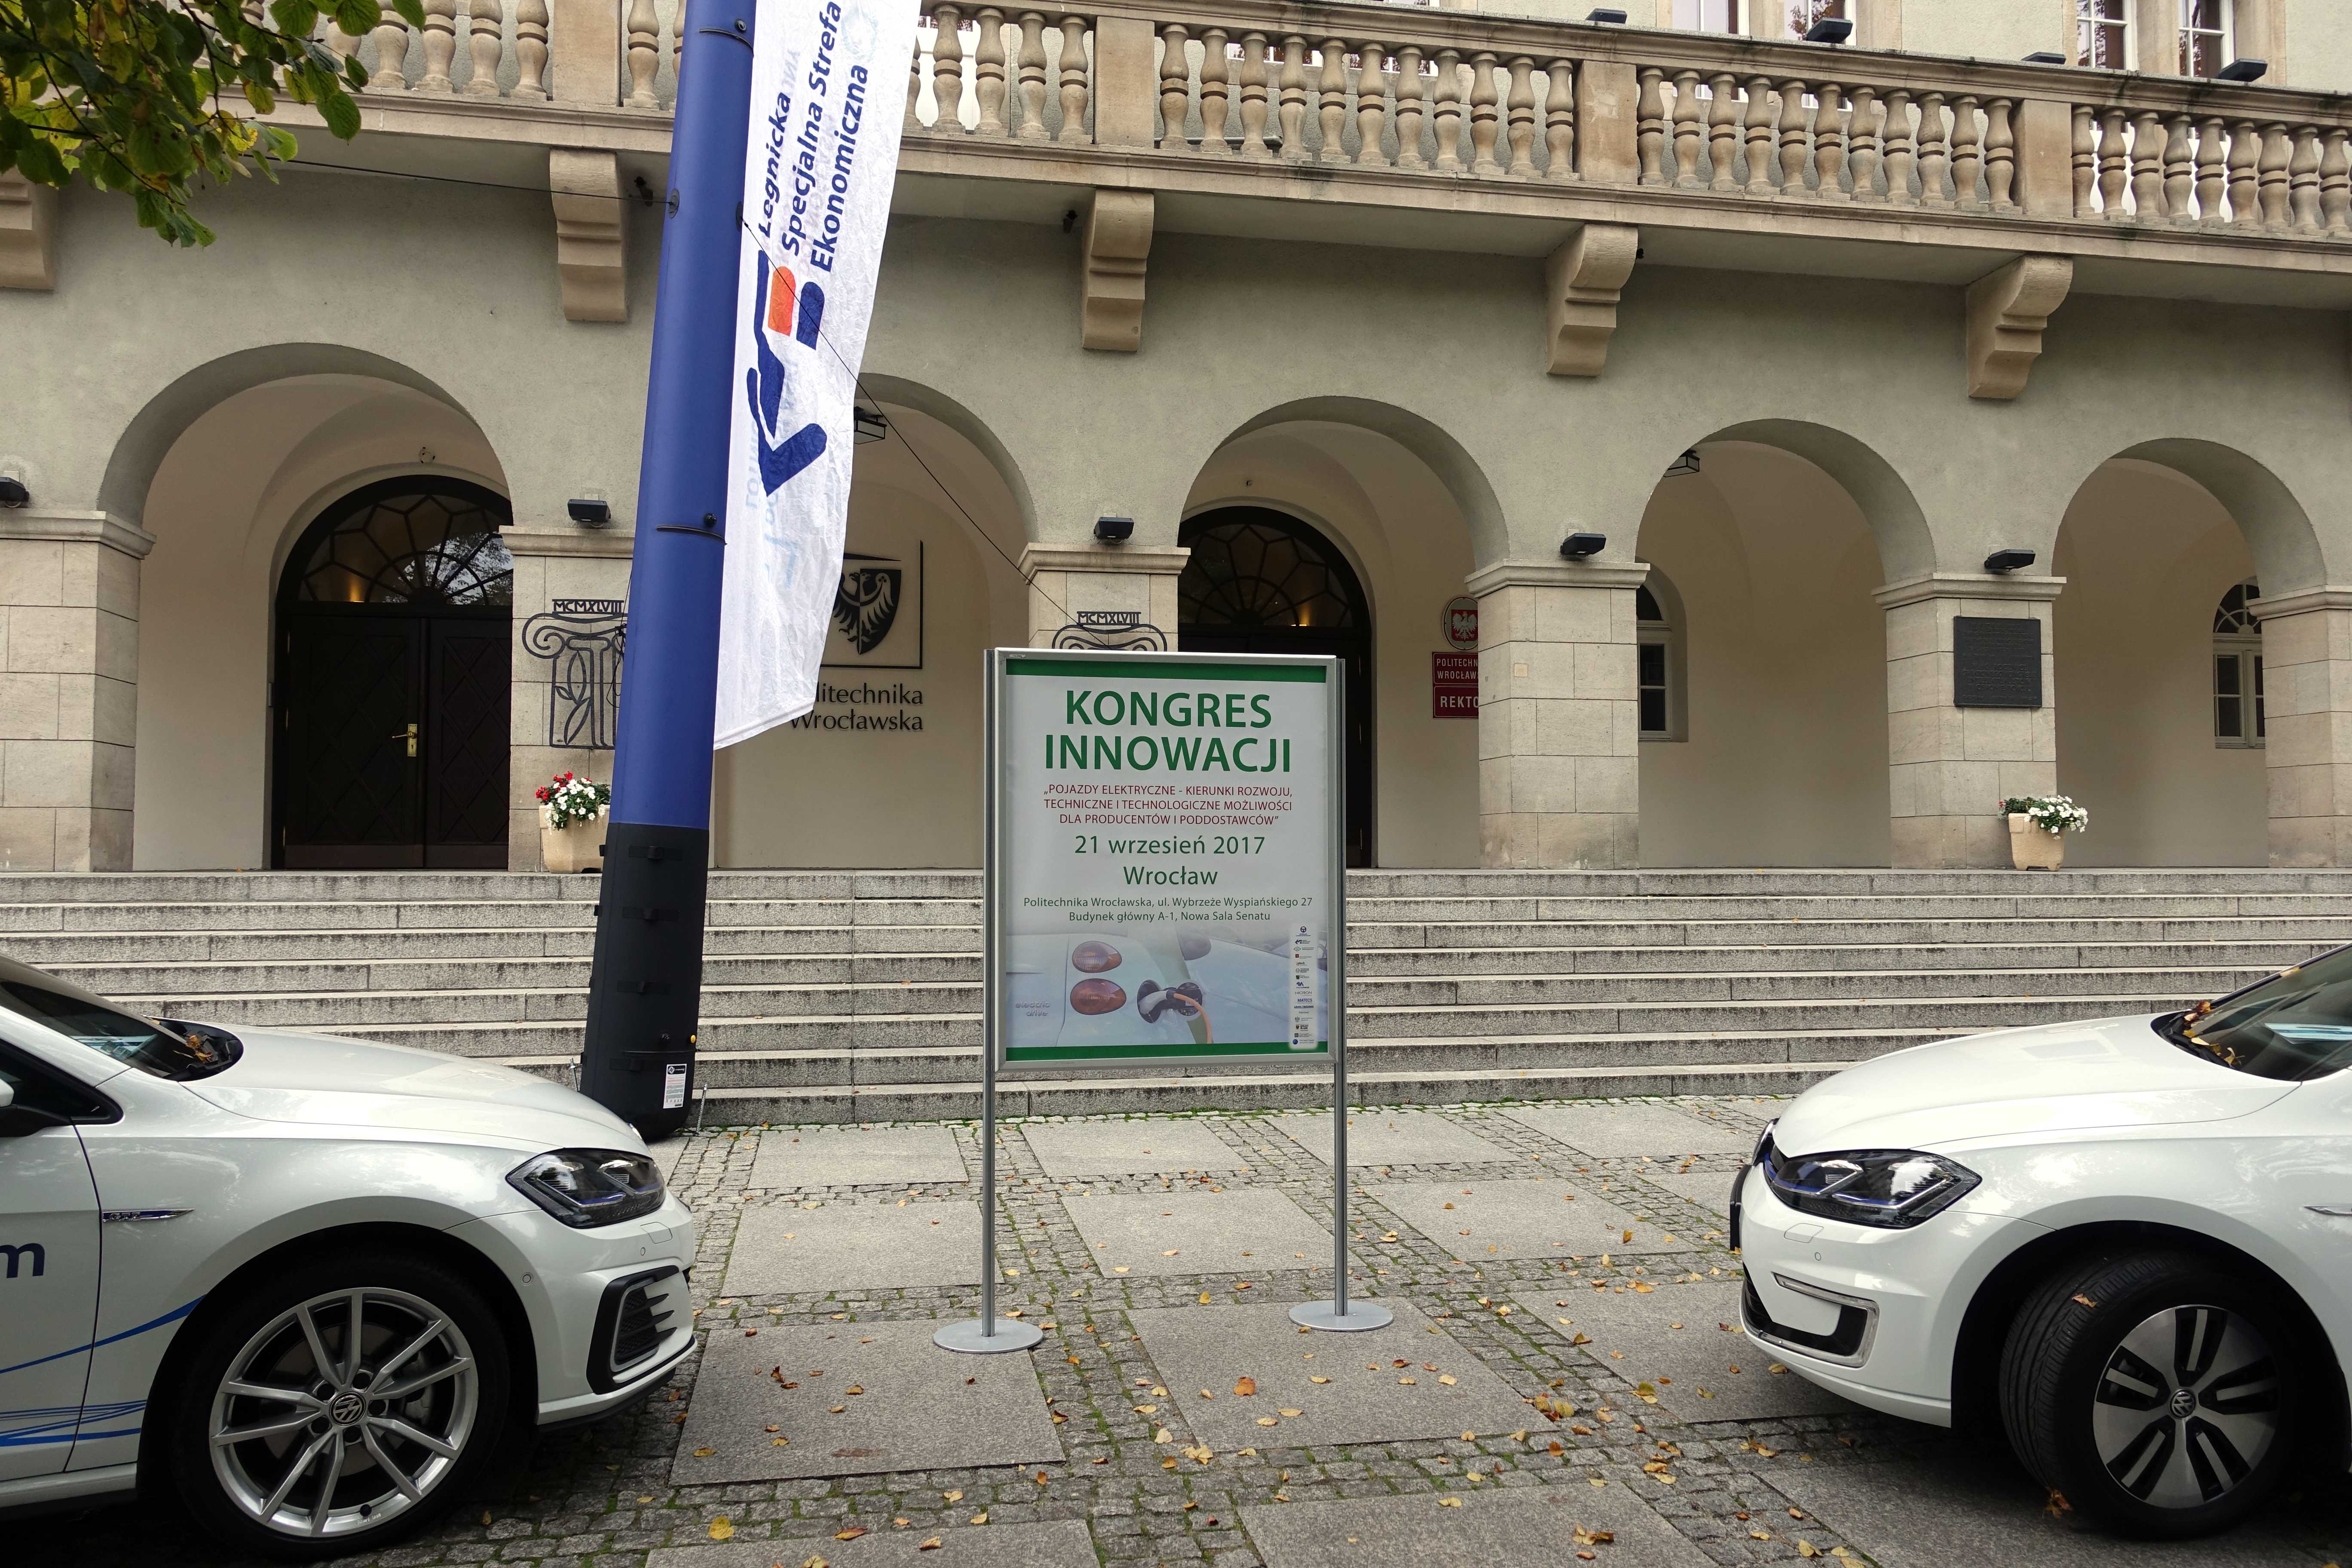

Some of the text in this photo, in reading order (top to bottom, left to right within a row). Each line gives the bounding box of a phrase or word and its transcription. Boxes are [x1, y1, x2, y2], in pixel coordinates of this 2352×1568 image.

[781, 101, 824, 257] Specjalna
[809, 1, 841, 97] Strefa
[757, 91, 791, 238] Legnicka
[810, 64, 868, 273] Ekonomiczna
[554, 600, 624, 613] MCMXLVIII
[1078, 612, 1140, 625] MCMXLVIII
[1436, 658, 1478, 667] POLITECHN
[1437, 671, 1479, 680] WROCŁAW
[816, 681, 923, 704] litechnika
[1440, 695, 1479, 708] REKTO
[1067, 690, 1271, 729] KONGRES
[791, 709, 923, 730] Wrocławska
[1046, 735, 1290, 772] INNOWACJI
[1102, 785, 1176, 795] ELEKTRYCZNE
[1186, 786, 1234, 796] KIERUNKI
[1238, 787, 1292, 798] ROZWOJU,
[1044, 799, 1292, 811] TECHNICZNE I TECHNOLOGICZNE MOŻLIWOŚCI
[1060, 814, 1081, 824] DLA
[1085, 813, 1170, 824] PRODUCENTÓW
[1174, 815, 1176, 824] I
[1075, 835, 1265, 854] 21 wrzesień 2017
[1123, 866, 1218, 885] Wrocław
[1024, 897, 1312, 909] Politechnika Wrocławska, ul. Wybrzeże Wyspiańskiego 27
[1069, 911, 1270, 923] Budynek główny A-1, Nowa Sala Senatu
